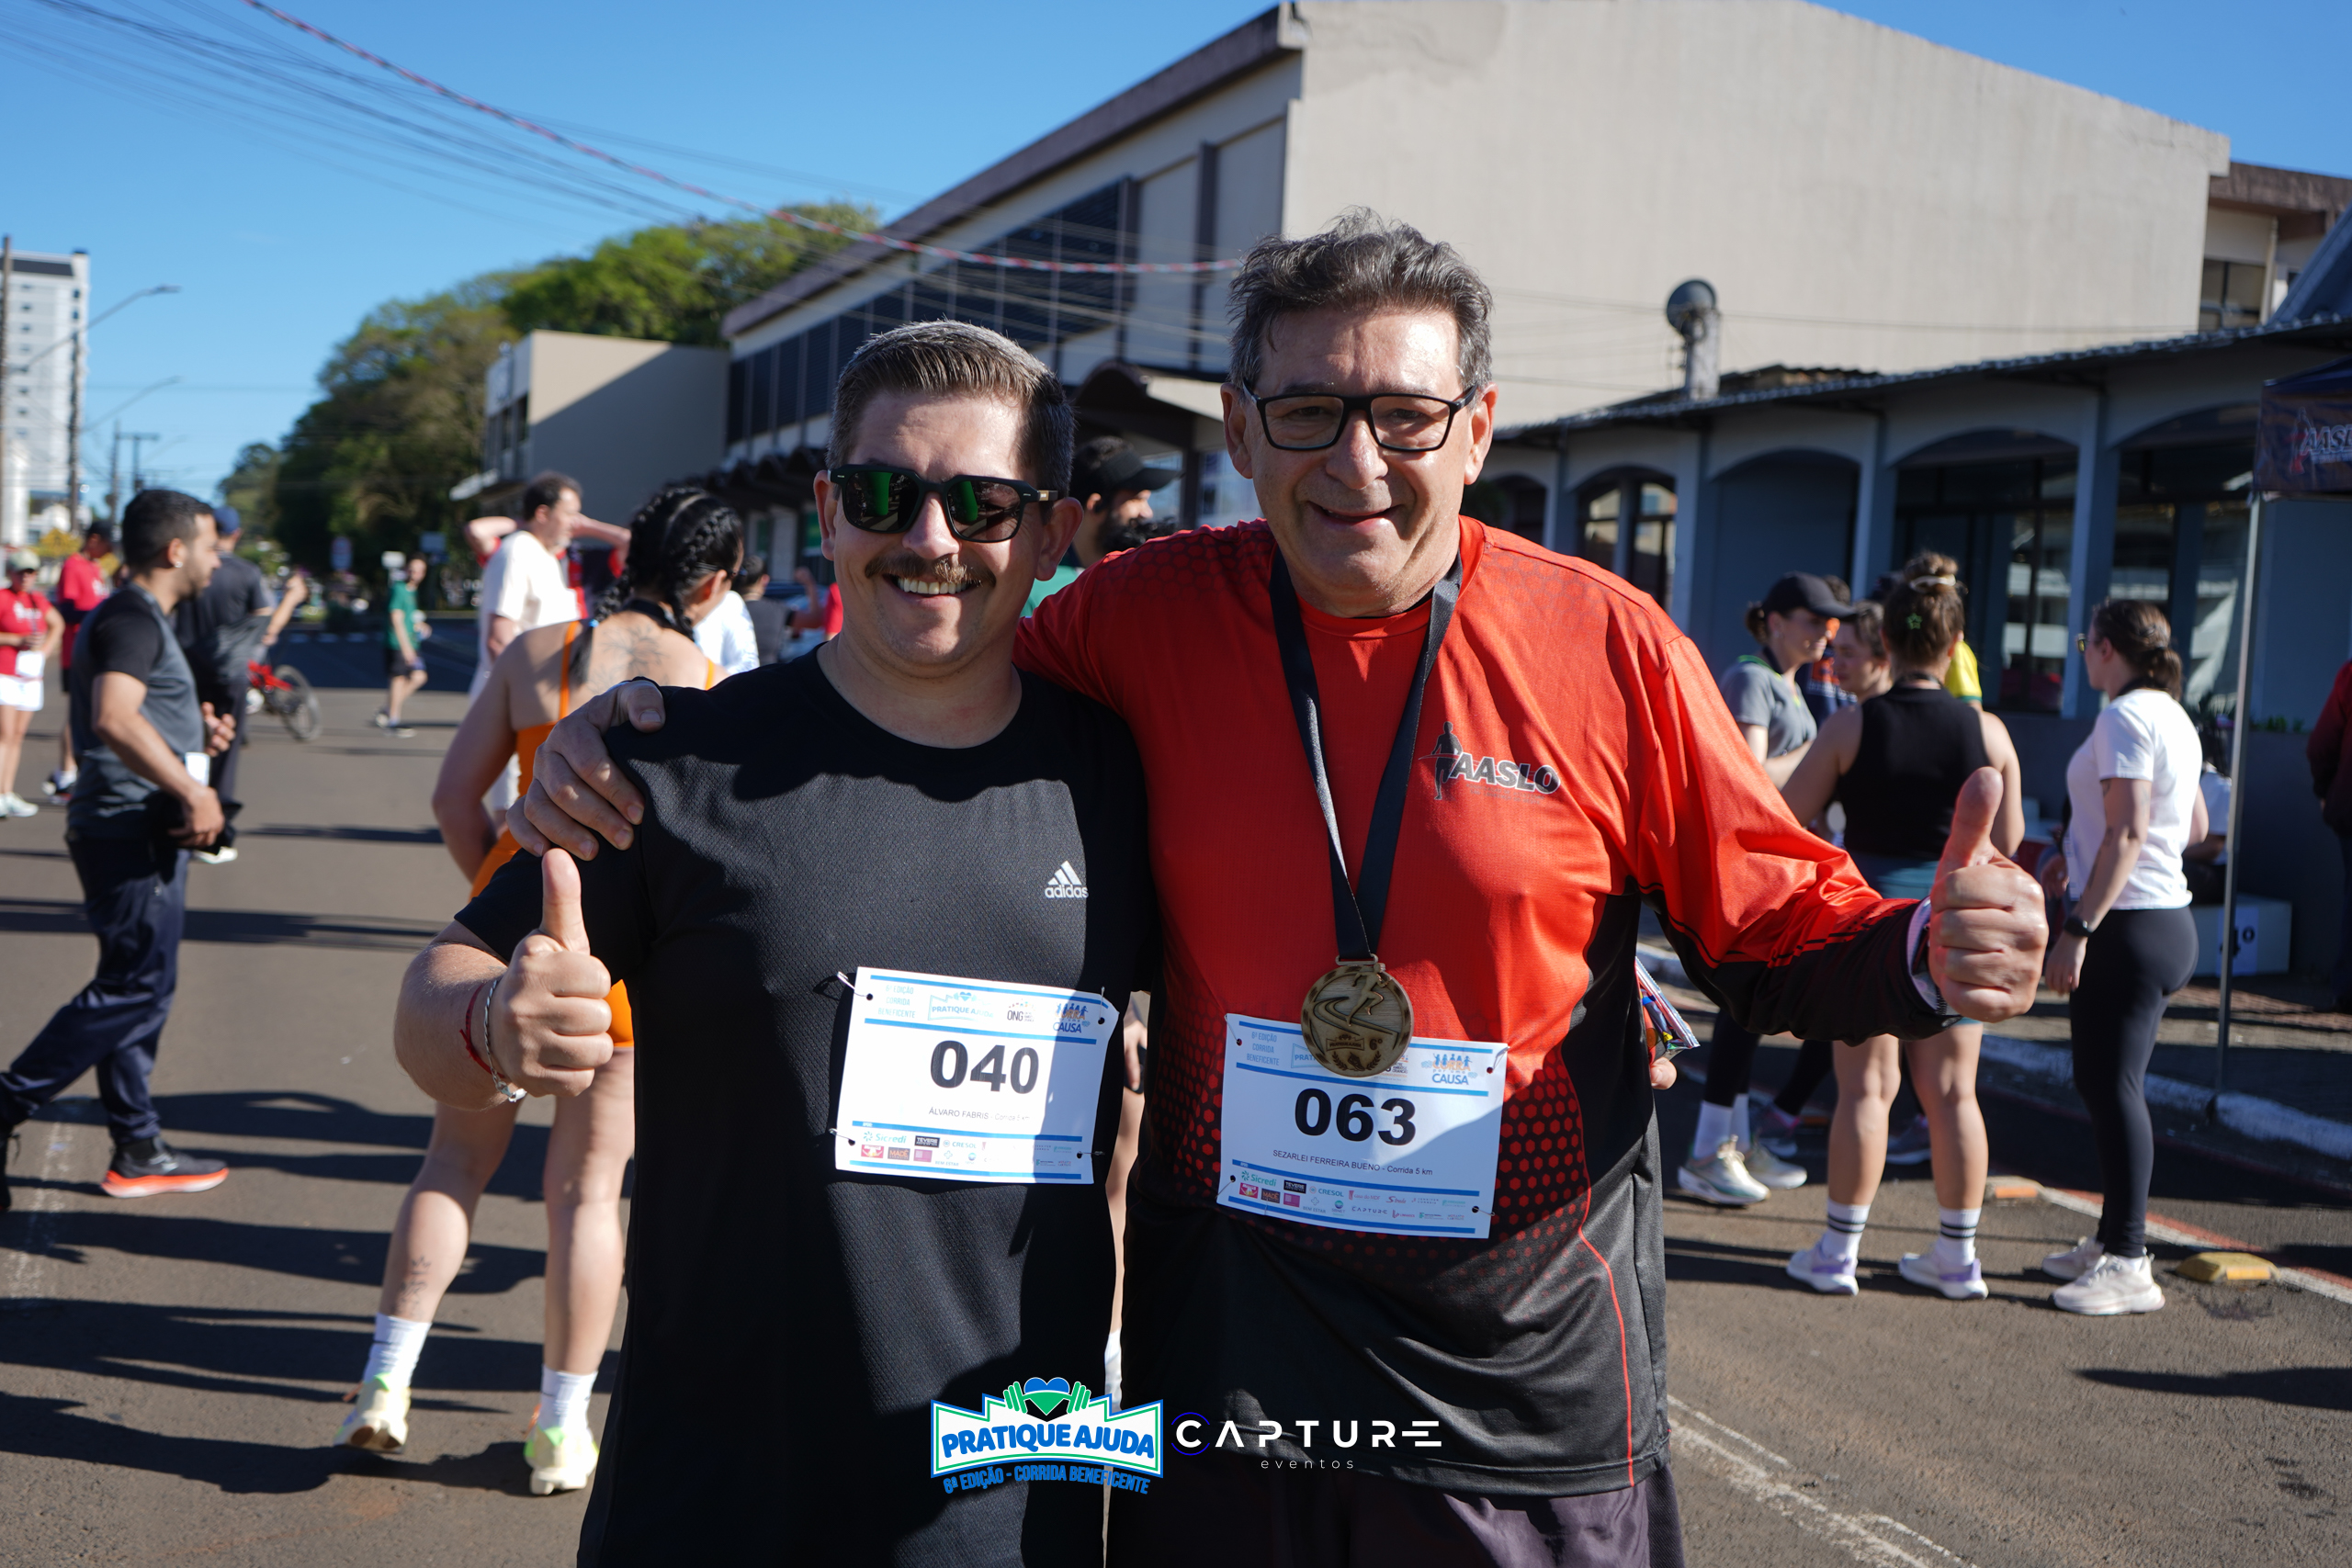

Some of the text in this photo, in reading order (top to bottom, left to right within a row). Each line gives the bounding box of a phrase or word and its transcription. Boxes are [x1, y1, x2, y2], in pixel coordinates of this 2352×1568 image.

[1448, 751, 1561, 795] AASLO
[1045, 884, 1089, 898] adidas
[893, 986, 914, 996] EDIÇÃO
[886, 997, 910, 1006] CORRIDA
[877, 1007, 916, 1019] BENEFICENTE
[932, 1006, 994, 1018] PRATIQUE AJUDA
[1007, 1010, 1023, 1021] ONG
[1053, 1021, 1082, 1033] CAUSA
[1258, 1032, 1278, 1043] EDIÇÃO
[1252, 1043, 1274, 1054] CORRIDA
[1246, 1054, 1280, 1066] BENEFICENTE
[931, 1040, 1039, 1094] 040
[1431, 1073, 1469, 1085] CAUSA
[928, 1106, 960, 1117] ÁLVARO
[962, 1111, 989, 1120] FABRIS
[1295, 1088, 1416, 1145] 063
[875, 1133, 907, 1144] Sicredi
[952, 1141, 977, 1149] CRESOL
[1272, 1149, 1308, 1162] SEZARLEI
[1310, 1156, 1350, 1168] FERREIRA
[1351, 1161, 1381, 1171] BUENO
[1386, 1165, 1414, 1175] Corrida
[1421, 1168, 1433, 1176] km
[1250, 1173, 1277, 1187] Sicredi
[1317, 1188, 1344, 1197] CRESOL
[1351, 1206, 1388, 1214] CAPTURE
